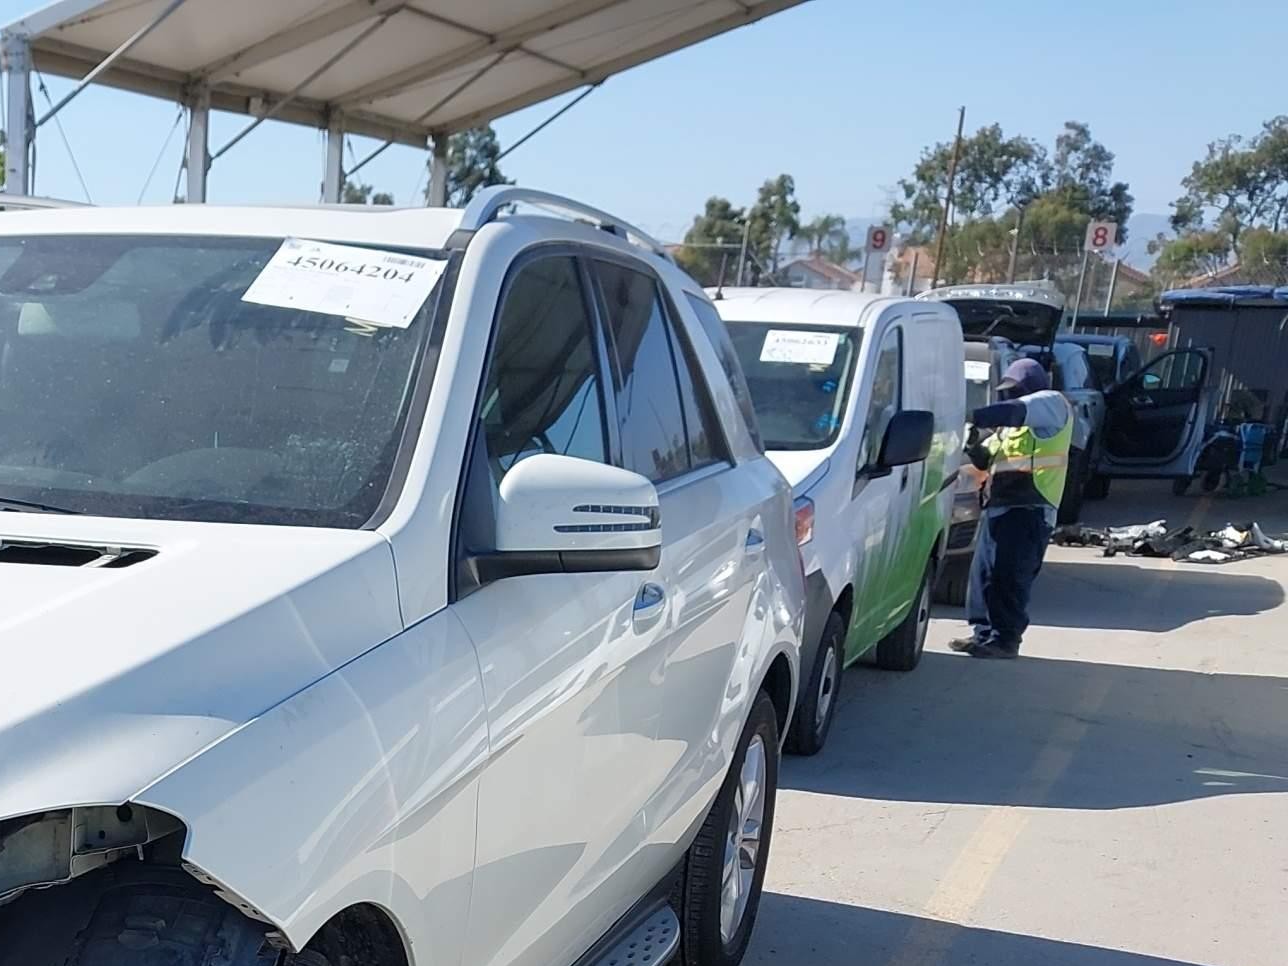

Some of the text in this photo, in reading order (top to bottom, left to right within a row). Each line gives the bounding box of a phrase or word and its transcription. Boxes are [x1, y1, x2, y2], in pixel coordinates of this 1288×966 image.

[873, 230, 886, 249] 9
[1093, 226, 1108, 247] 8
[287, 255, 415, 283] 45064204
